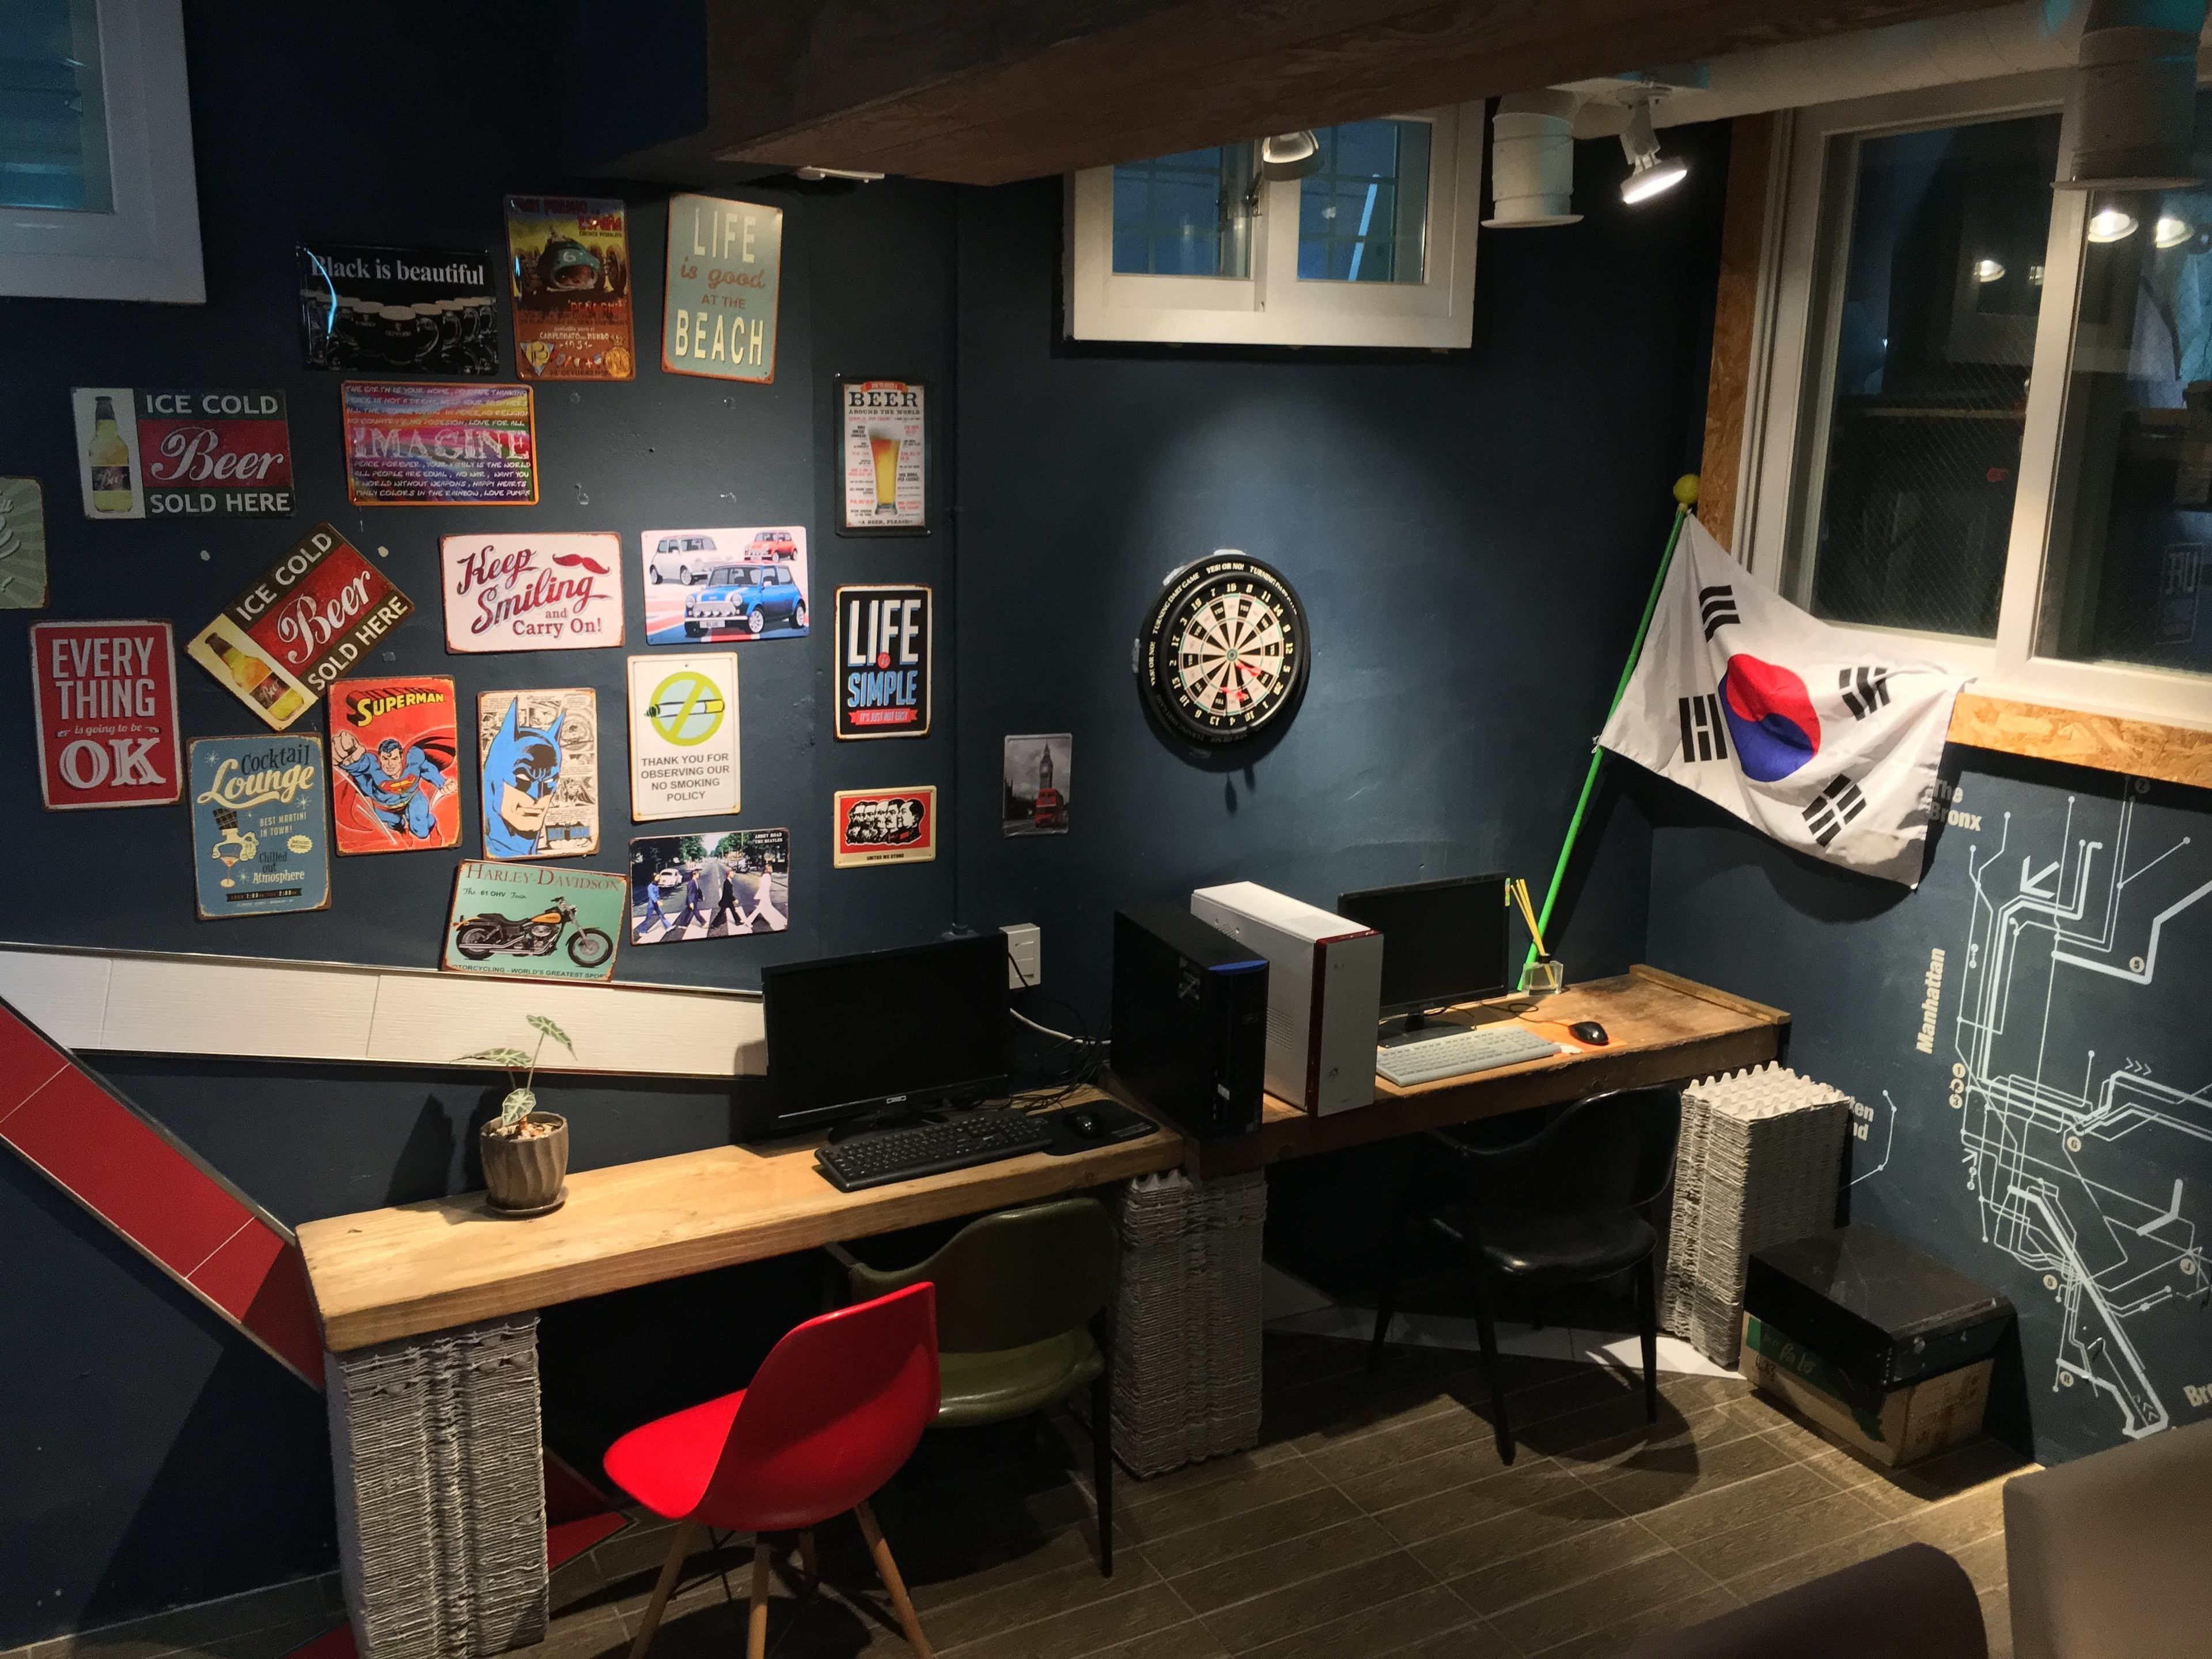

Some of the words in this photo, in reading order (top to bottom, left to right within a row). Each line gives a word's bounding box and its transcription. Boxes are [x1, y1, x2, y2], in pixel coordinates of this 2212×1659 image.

[694, 207, 756, 263] LIFE
[312, 256, 370, 278] Black
[376, 259, 391, 279] is
[397, 260, 484, 285] beautiful
[681, 256, 698, 279] is
[708, 269, 766, 289] good
[702, 294, 719, 305] AT
[722, 296, 746, 309] THE
[675, 309, 763, 366] BEACH
[147, 395, 192, 414] ICE
[202, 395, 278, 415] COLD
[849, 392, 918, 407] BEER
[354, 427, 529, 460] IMAGINE
[150, 427, 283, 482] Beer
[151, 494, 216, 514] SOLD
[226, 494, 290, 512] HERE
[236, 585, 278, 621] ICE
[275, 532, 332, 586] COLD
[457, 545, 539, 595] Keep
[472, 567, 612, 634] Smiling
[1211, 588, 1216, 597] 7
[1261, 591, 1271, 603] 11
[546, 608, 567, 618] and
[1153, 601, 1170, 634] TURNING
[1182, 573, 1200, 588] GAME
[1191, 598, 1202, 611] 19
[276, 570, 370, 664] Beer
[1180, 618, 1187, 626] 3
[513, 620, 564, 638] Carry
[571, 618, 601, 633] On!
[849, 600, 921, 666] LIFE
[308, 643, 358, 691] SOLD
[355, 596, 408, 646] HERE
[1172, 635, 1180, 647] 17
[1285, 642, 1293, 654] 12
[52, 637, 154, 678] EVERY
[55, 679, 155, 719] THING
[258, 679, 283, 700] Beer
[848, 671, 918, 707] SIMPLE
[356, 692, 444, 727] SUPERMAN
[860, 713, 869, 722] IT'S
[870, 712, 882, 722] JUST
[884, 712, 894, 721] NOT
[895, 711, 908, 721] EASY
[74, 725, 83, 734] is
[86, 725, 115, 736] going
[118, 724, 127, 732] to
[131, 724, 142, 732] be
[1210, 717, 1219, 726] 13
[1230, 717, 1236, 726] 4
[60, 737, 166, 789] OK
[241, 744, 309, 775] Cocktail
[641, 756, 679, 766] THANK
[681, 754, 704, 764] YOU
[707, 753, 729, 762] FOR
[641, 767, 704, 779] OBSERVING
[707, 765, 730, 774] OUR
[196, 759, 315, 809] Lounge
[652, 781, 667, 790] NO
[670, 778, 720, 789] SMOKING
[1933, 779, 1963, 803] The
[667, 791, 706, 802] POLICY
[260, 816, 275, 827] BEST
[279, 812, 306, 823] MARTINI
[1930, 801, 1982, 831] Bronx
[271, 825, 292, 836] TOWN!
[260, 852, 287, 862] Chilled
[252, 870, 305, 884] Atmosphere
[262, 862, 276, 873] out
[463, 887, 476, 895] The
[546, 969, 582, 978] GREATEST
[1916, 948, 1945, 1055] Manhattan
[1849, 1096, 1874, 1122] ten
